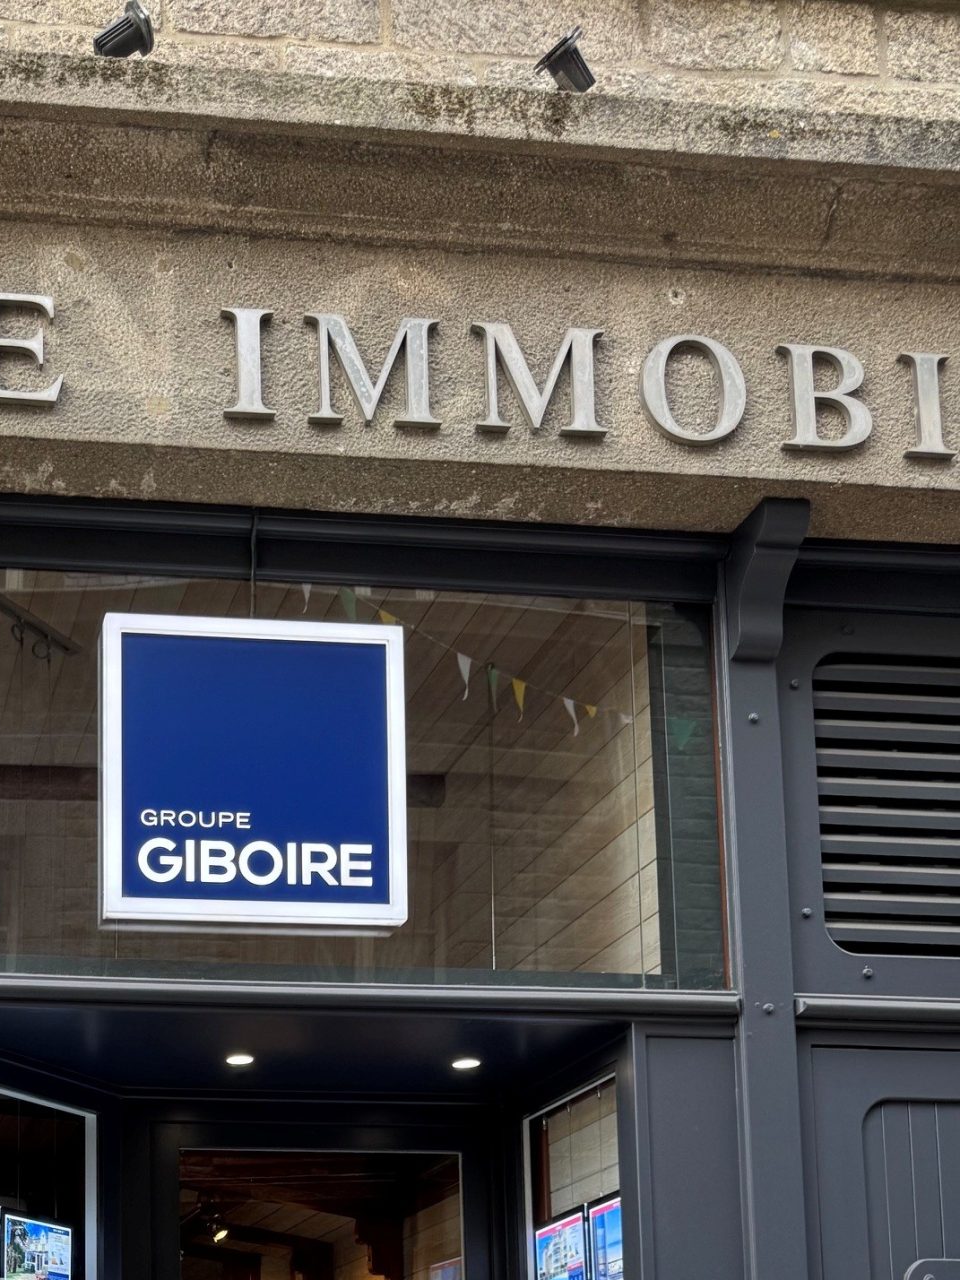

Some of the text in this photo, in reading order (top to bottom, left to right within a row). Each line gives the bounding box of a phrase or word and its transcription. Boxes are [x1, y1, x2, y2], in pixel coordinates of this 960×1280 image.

[221, 306, 958, 460] IMMOBI
[140, 808, 251, 829] GROUPE
[138, 837, 372, 887] GIBOIRE
